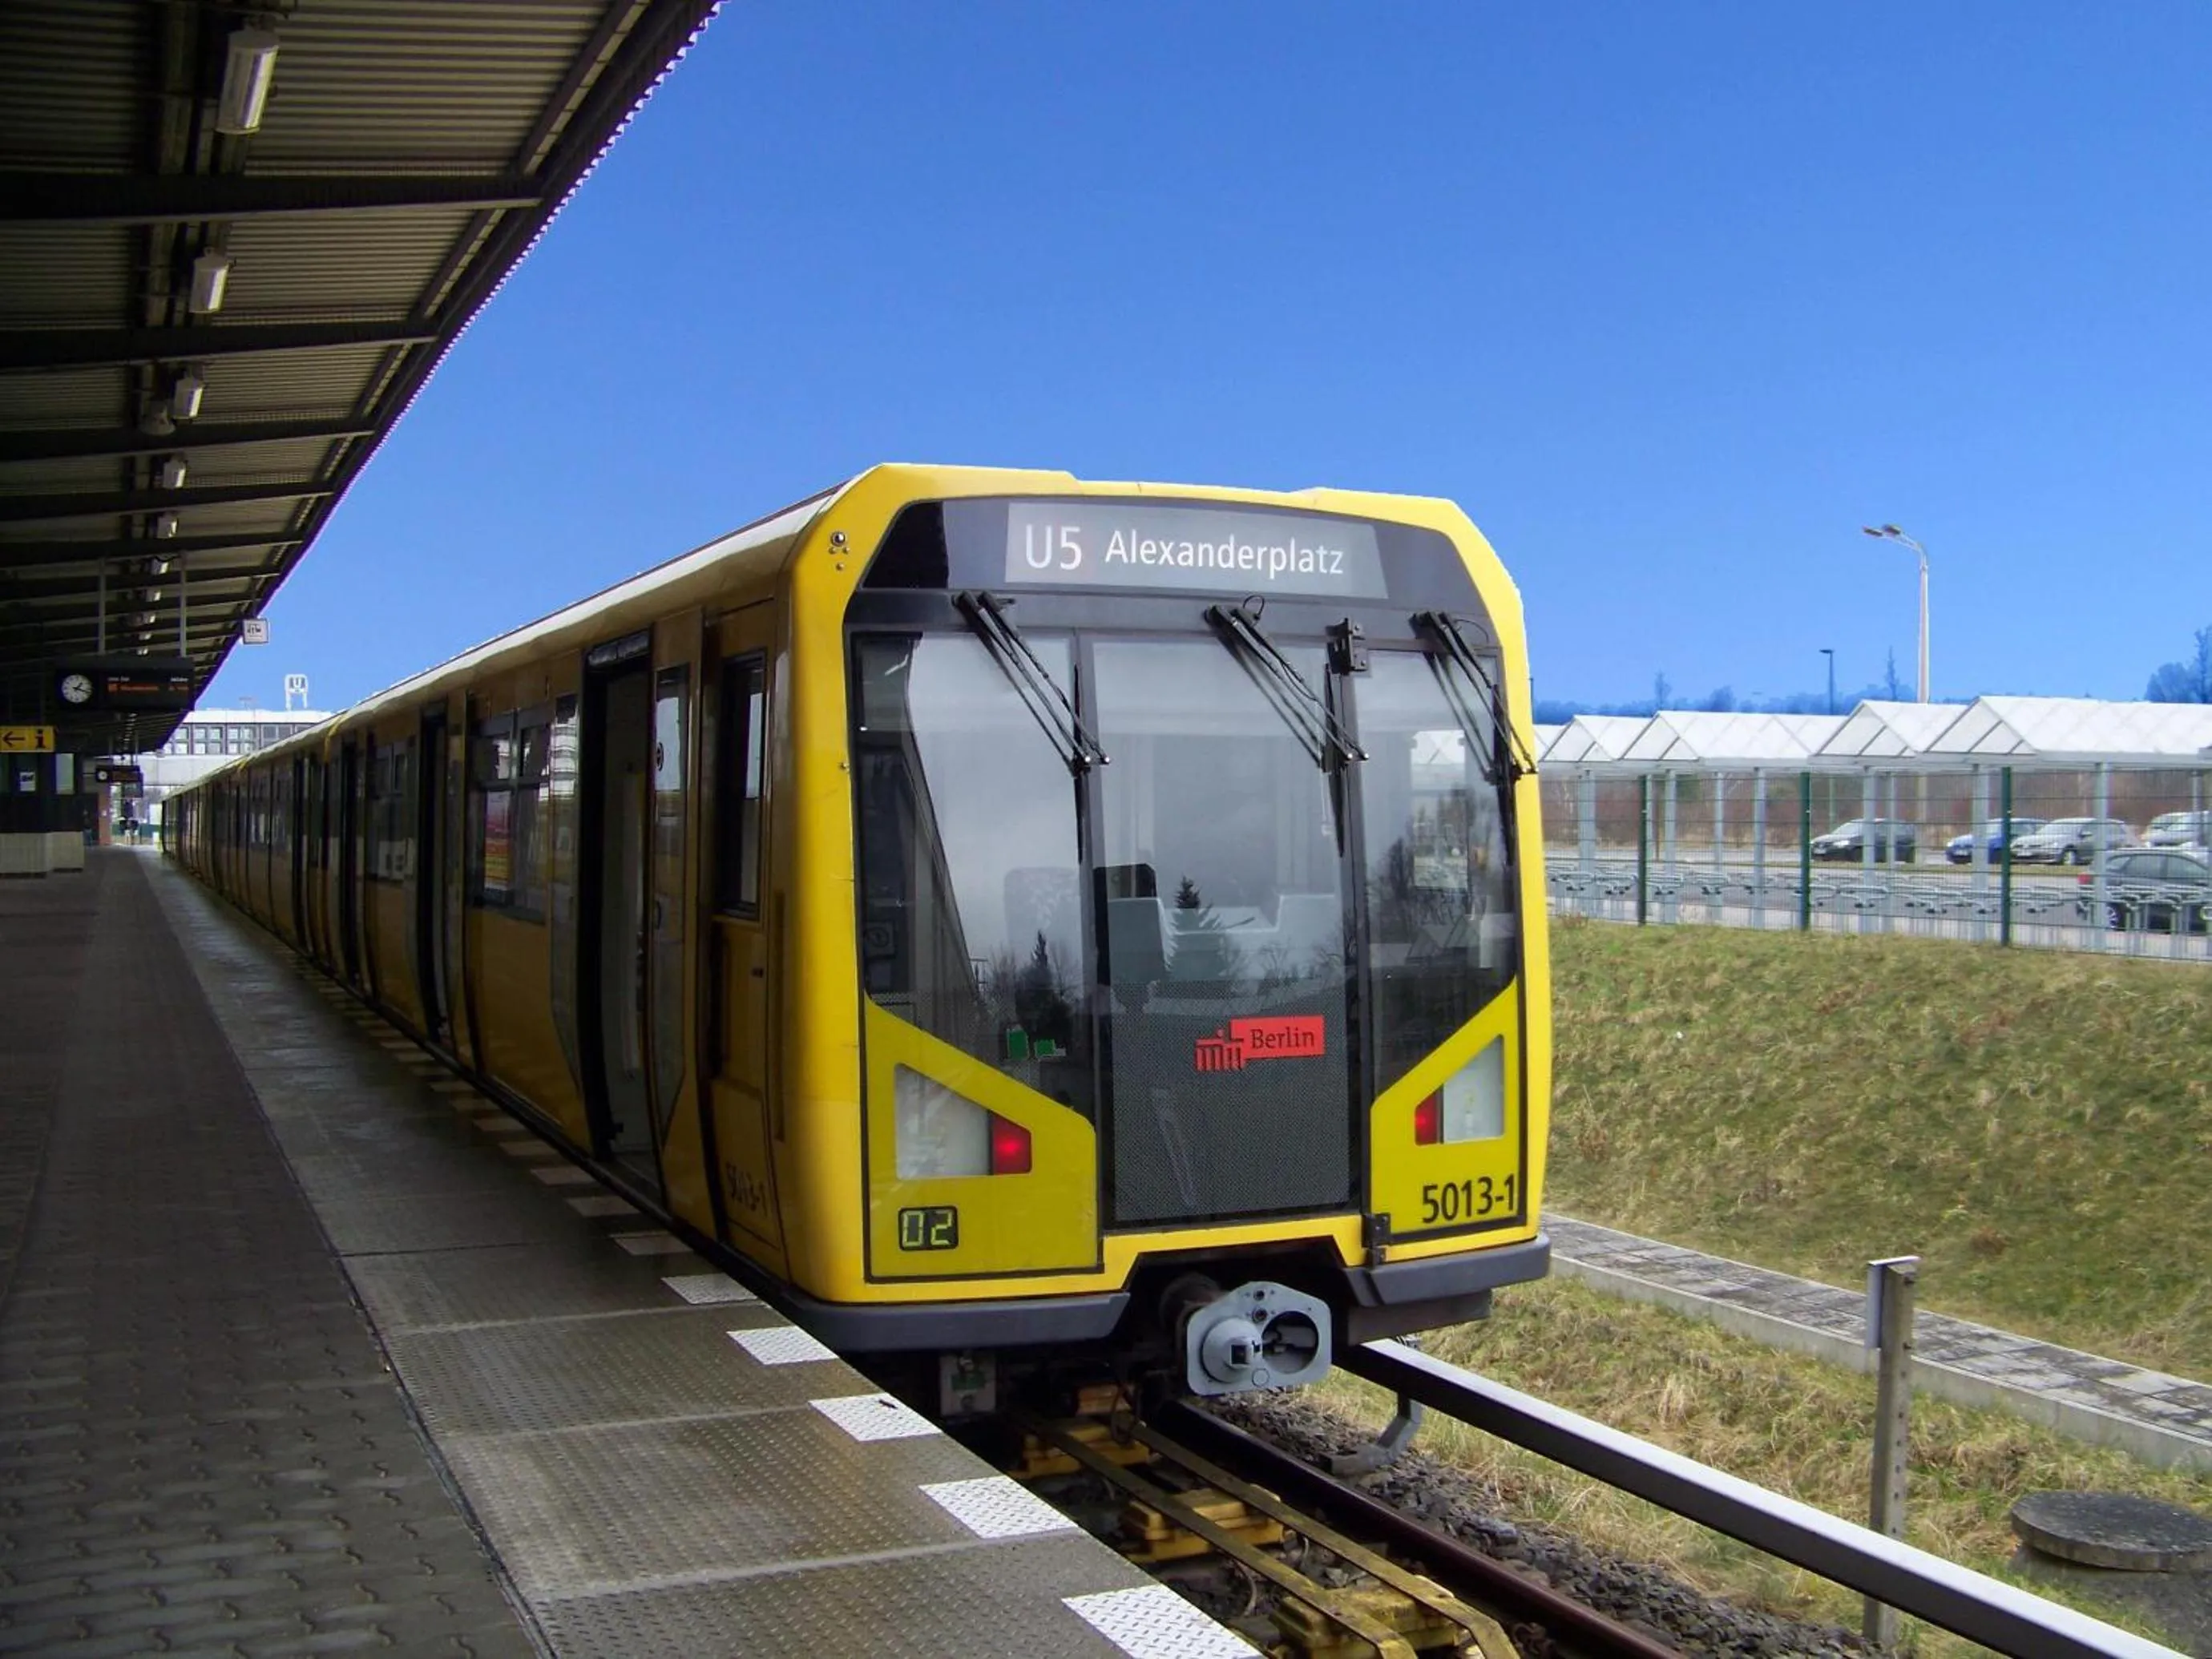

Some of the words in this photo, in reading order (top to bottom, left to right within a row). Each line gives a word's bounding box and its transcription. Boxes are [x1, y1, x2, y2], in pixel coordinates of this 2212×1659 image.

[1025, 524, 1082, 570] U5
[1105, 528, 1344, 579] Alexanderplatz
[1250, 1027, 1314, 1048] Berlin
[1423, 1173, 1514, 1223] 5013-1
[902, 1209, 952, 1247] 02
